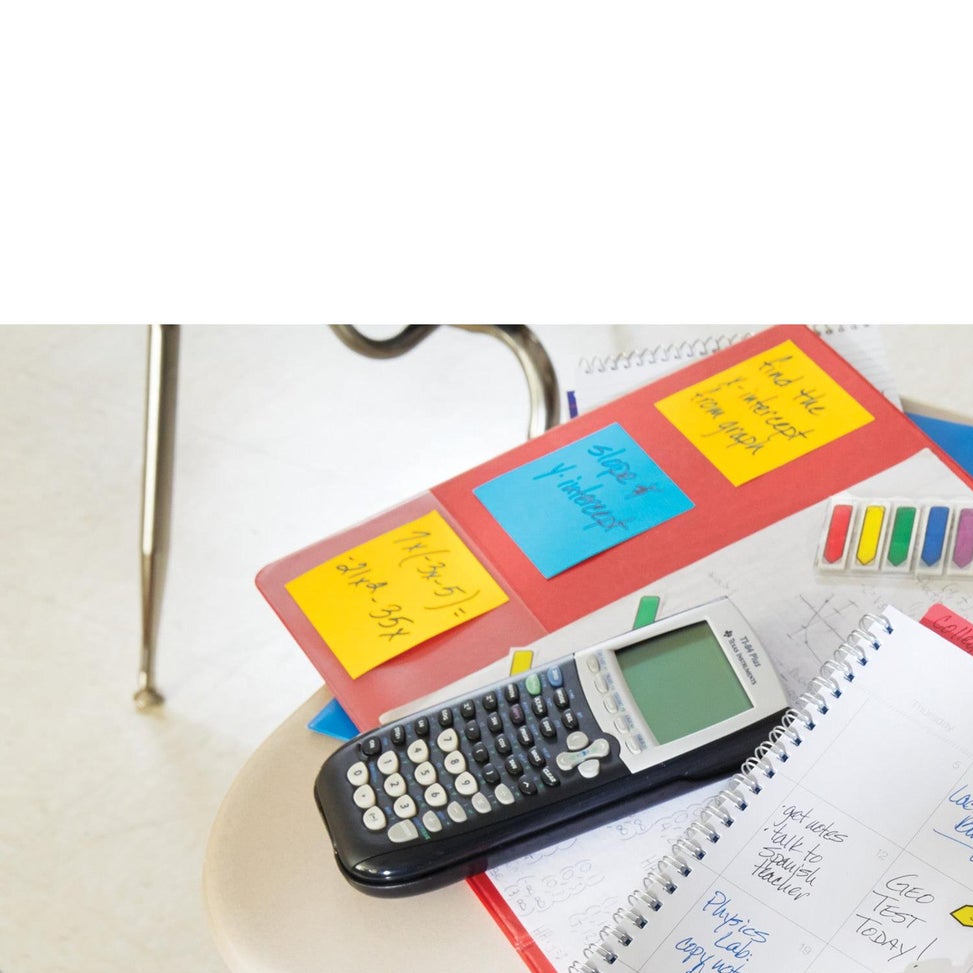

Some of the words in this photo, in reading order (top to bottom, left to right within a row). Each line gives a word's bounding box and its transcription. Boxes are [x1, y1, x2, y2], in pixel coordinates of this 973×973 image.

[690, 385, 724, 420] from
[758, 355, 804, 387] find
[792, 388, 826, 416] the
[701, 420, 769, 456] graph
[587, 444, 636, 484] slope
[771, 823, 803, 853] talk
[804, 844, 823, 864] to
[774, 806, 814, 827] get
[805, 822, 848, 843] notes
[751, 858, 809, 900] teacher
[885, 874, 935, 904] GEO
[702, 890, 770, 944] Physics
[872, 890, 926, 928] TEST
[675, 937, 712, 973] copy
